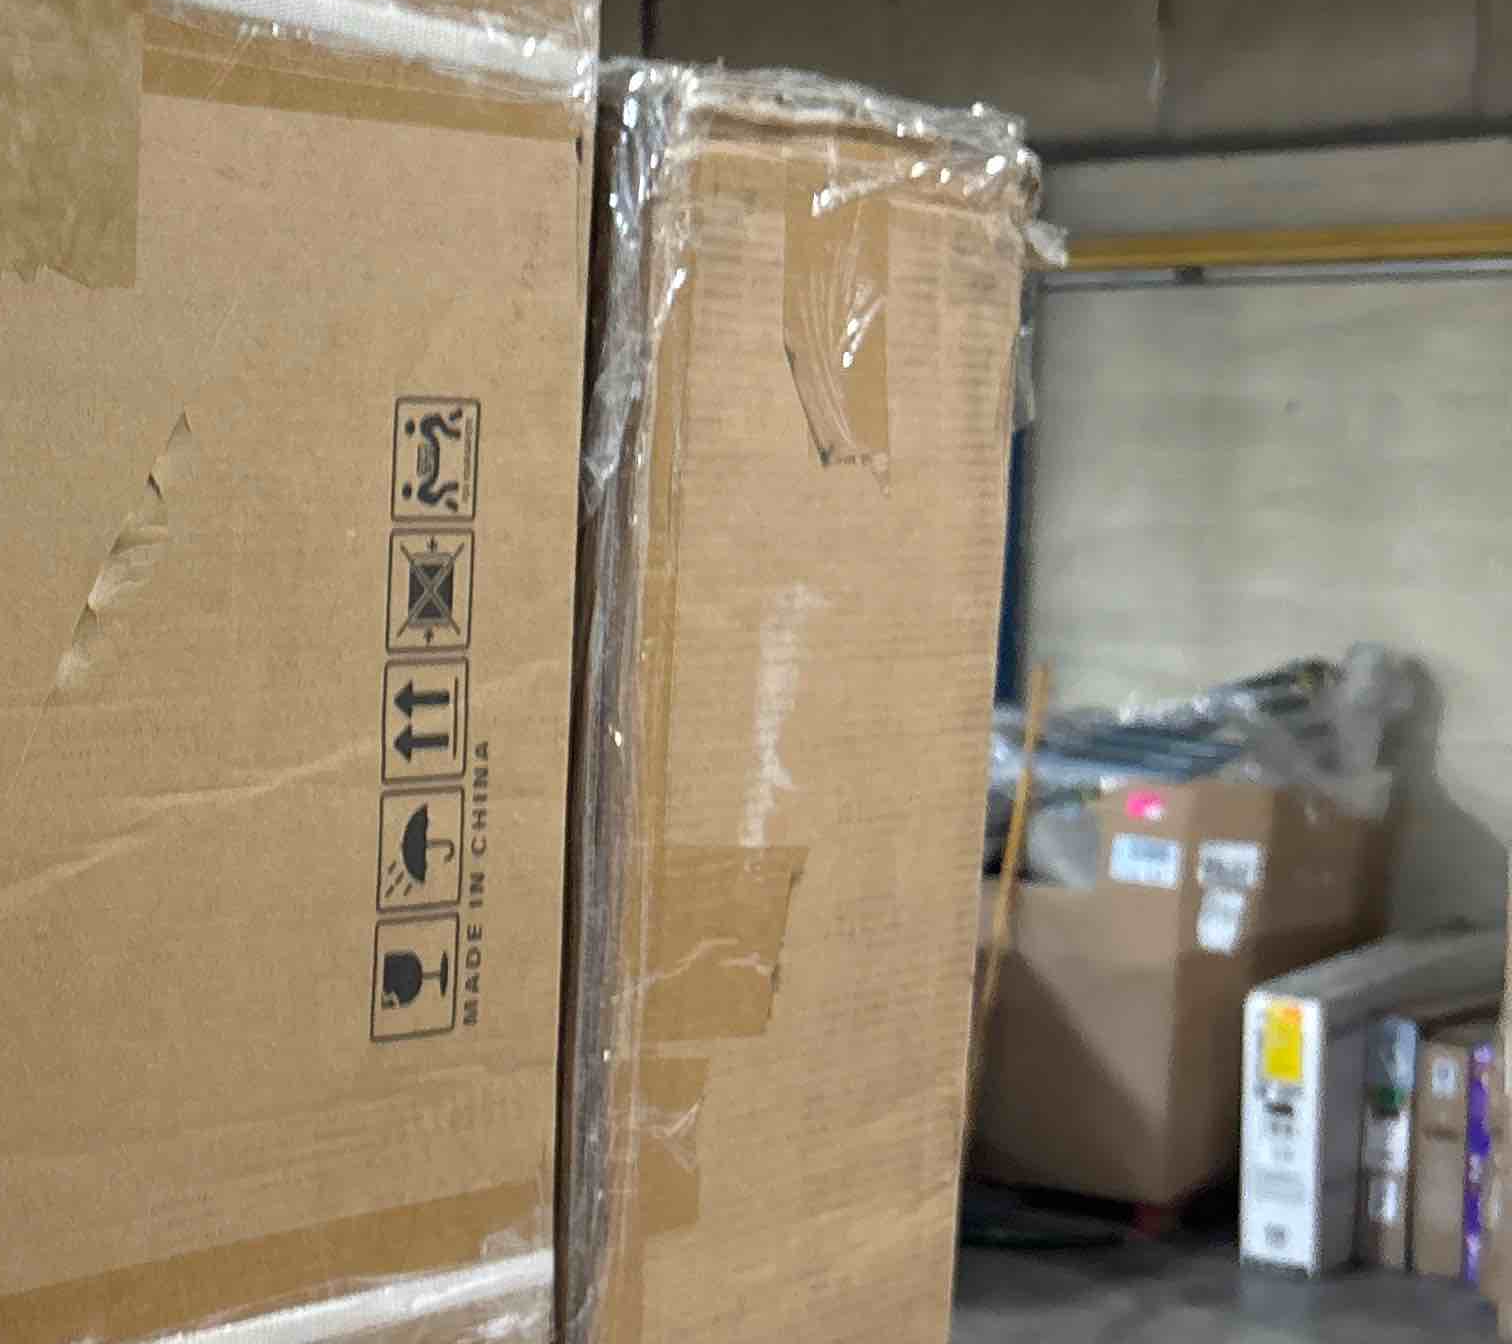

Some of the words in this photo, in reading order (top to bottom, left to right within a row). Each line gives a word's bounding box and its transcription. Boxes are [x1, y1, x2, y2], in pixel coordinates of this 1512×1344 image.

[472, 739, 490, 862] CHINA
[469, 872, 484, 911] IN
[464, 924, 482, 1027] MADE
